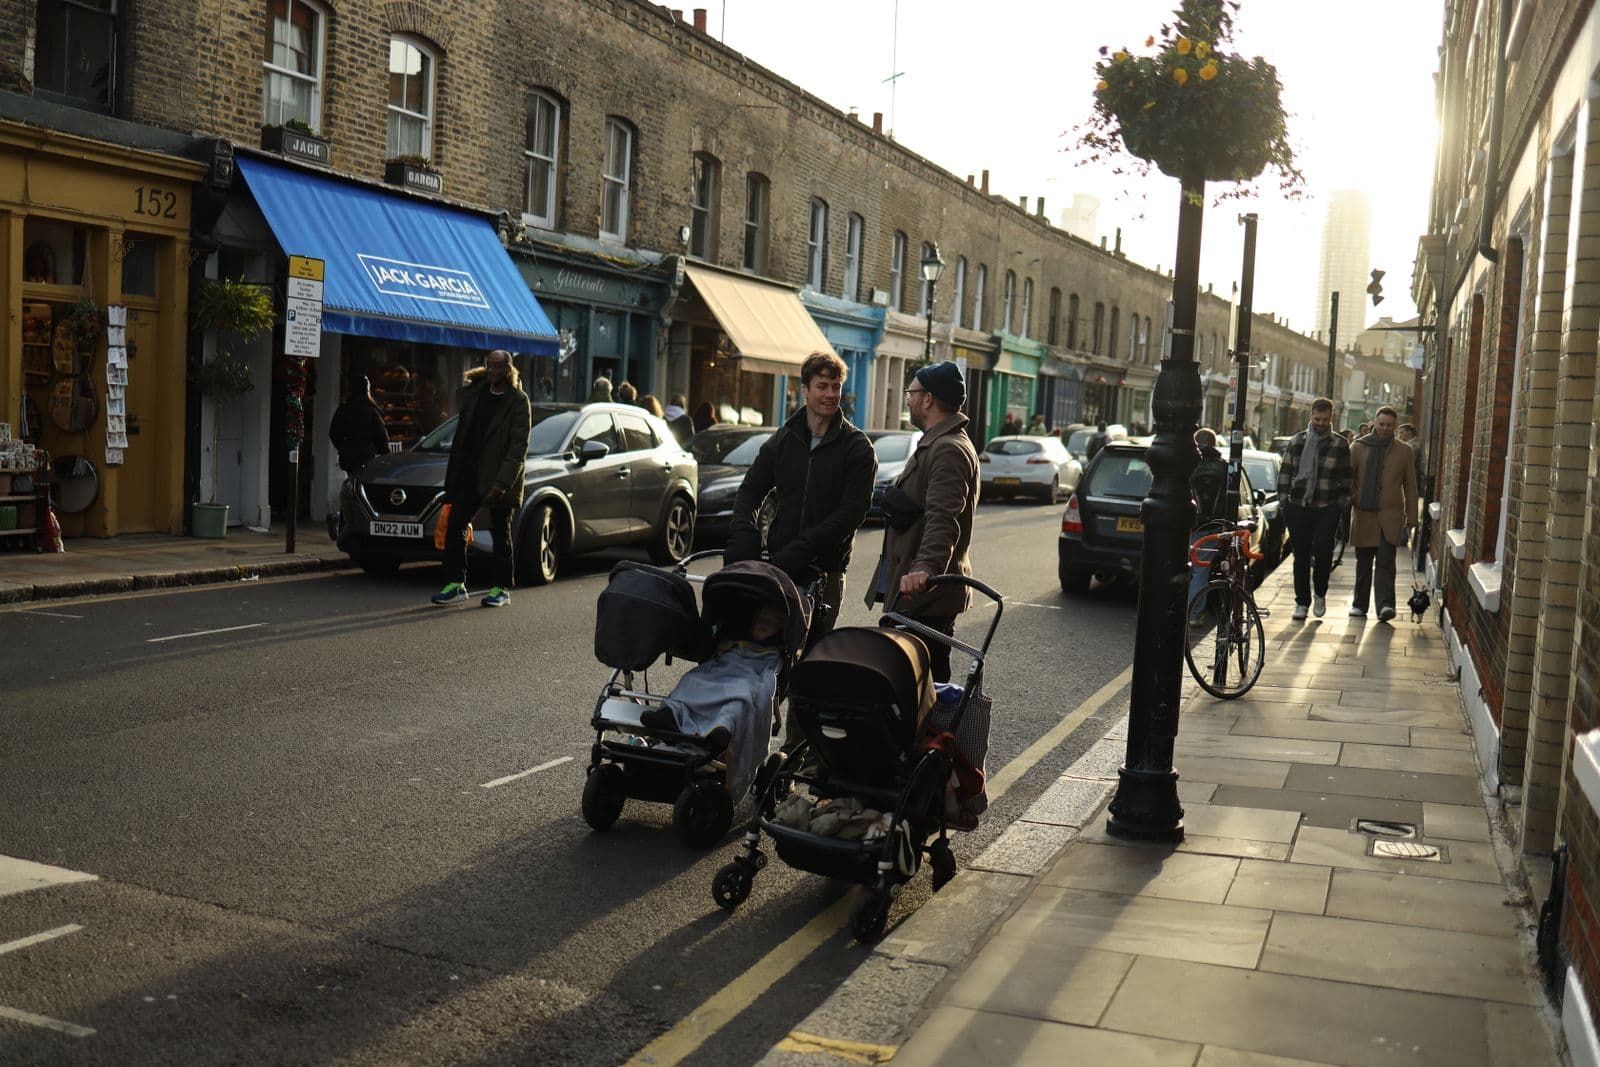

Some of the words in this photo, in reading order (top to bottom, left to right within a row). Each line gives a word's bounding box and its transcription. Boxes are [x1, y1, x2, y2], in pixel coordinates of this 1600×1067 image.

[292, 139, 320, 157] JACK
[408, 171, 439, 189] GARCIA
[134, 186, 177, 218] 152
[371, 264, 417, 287] JACK
[415, 273, 478, 295] GARCIA
[374, 523, 398, 535] DN22
